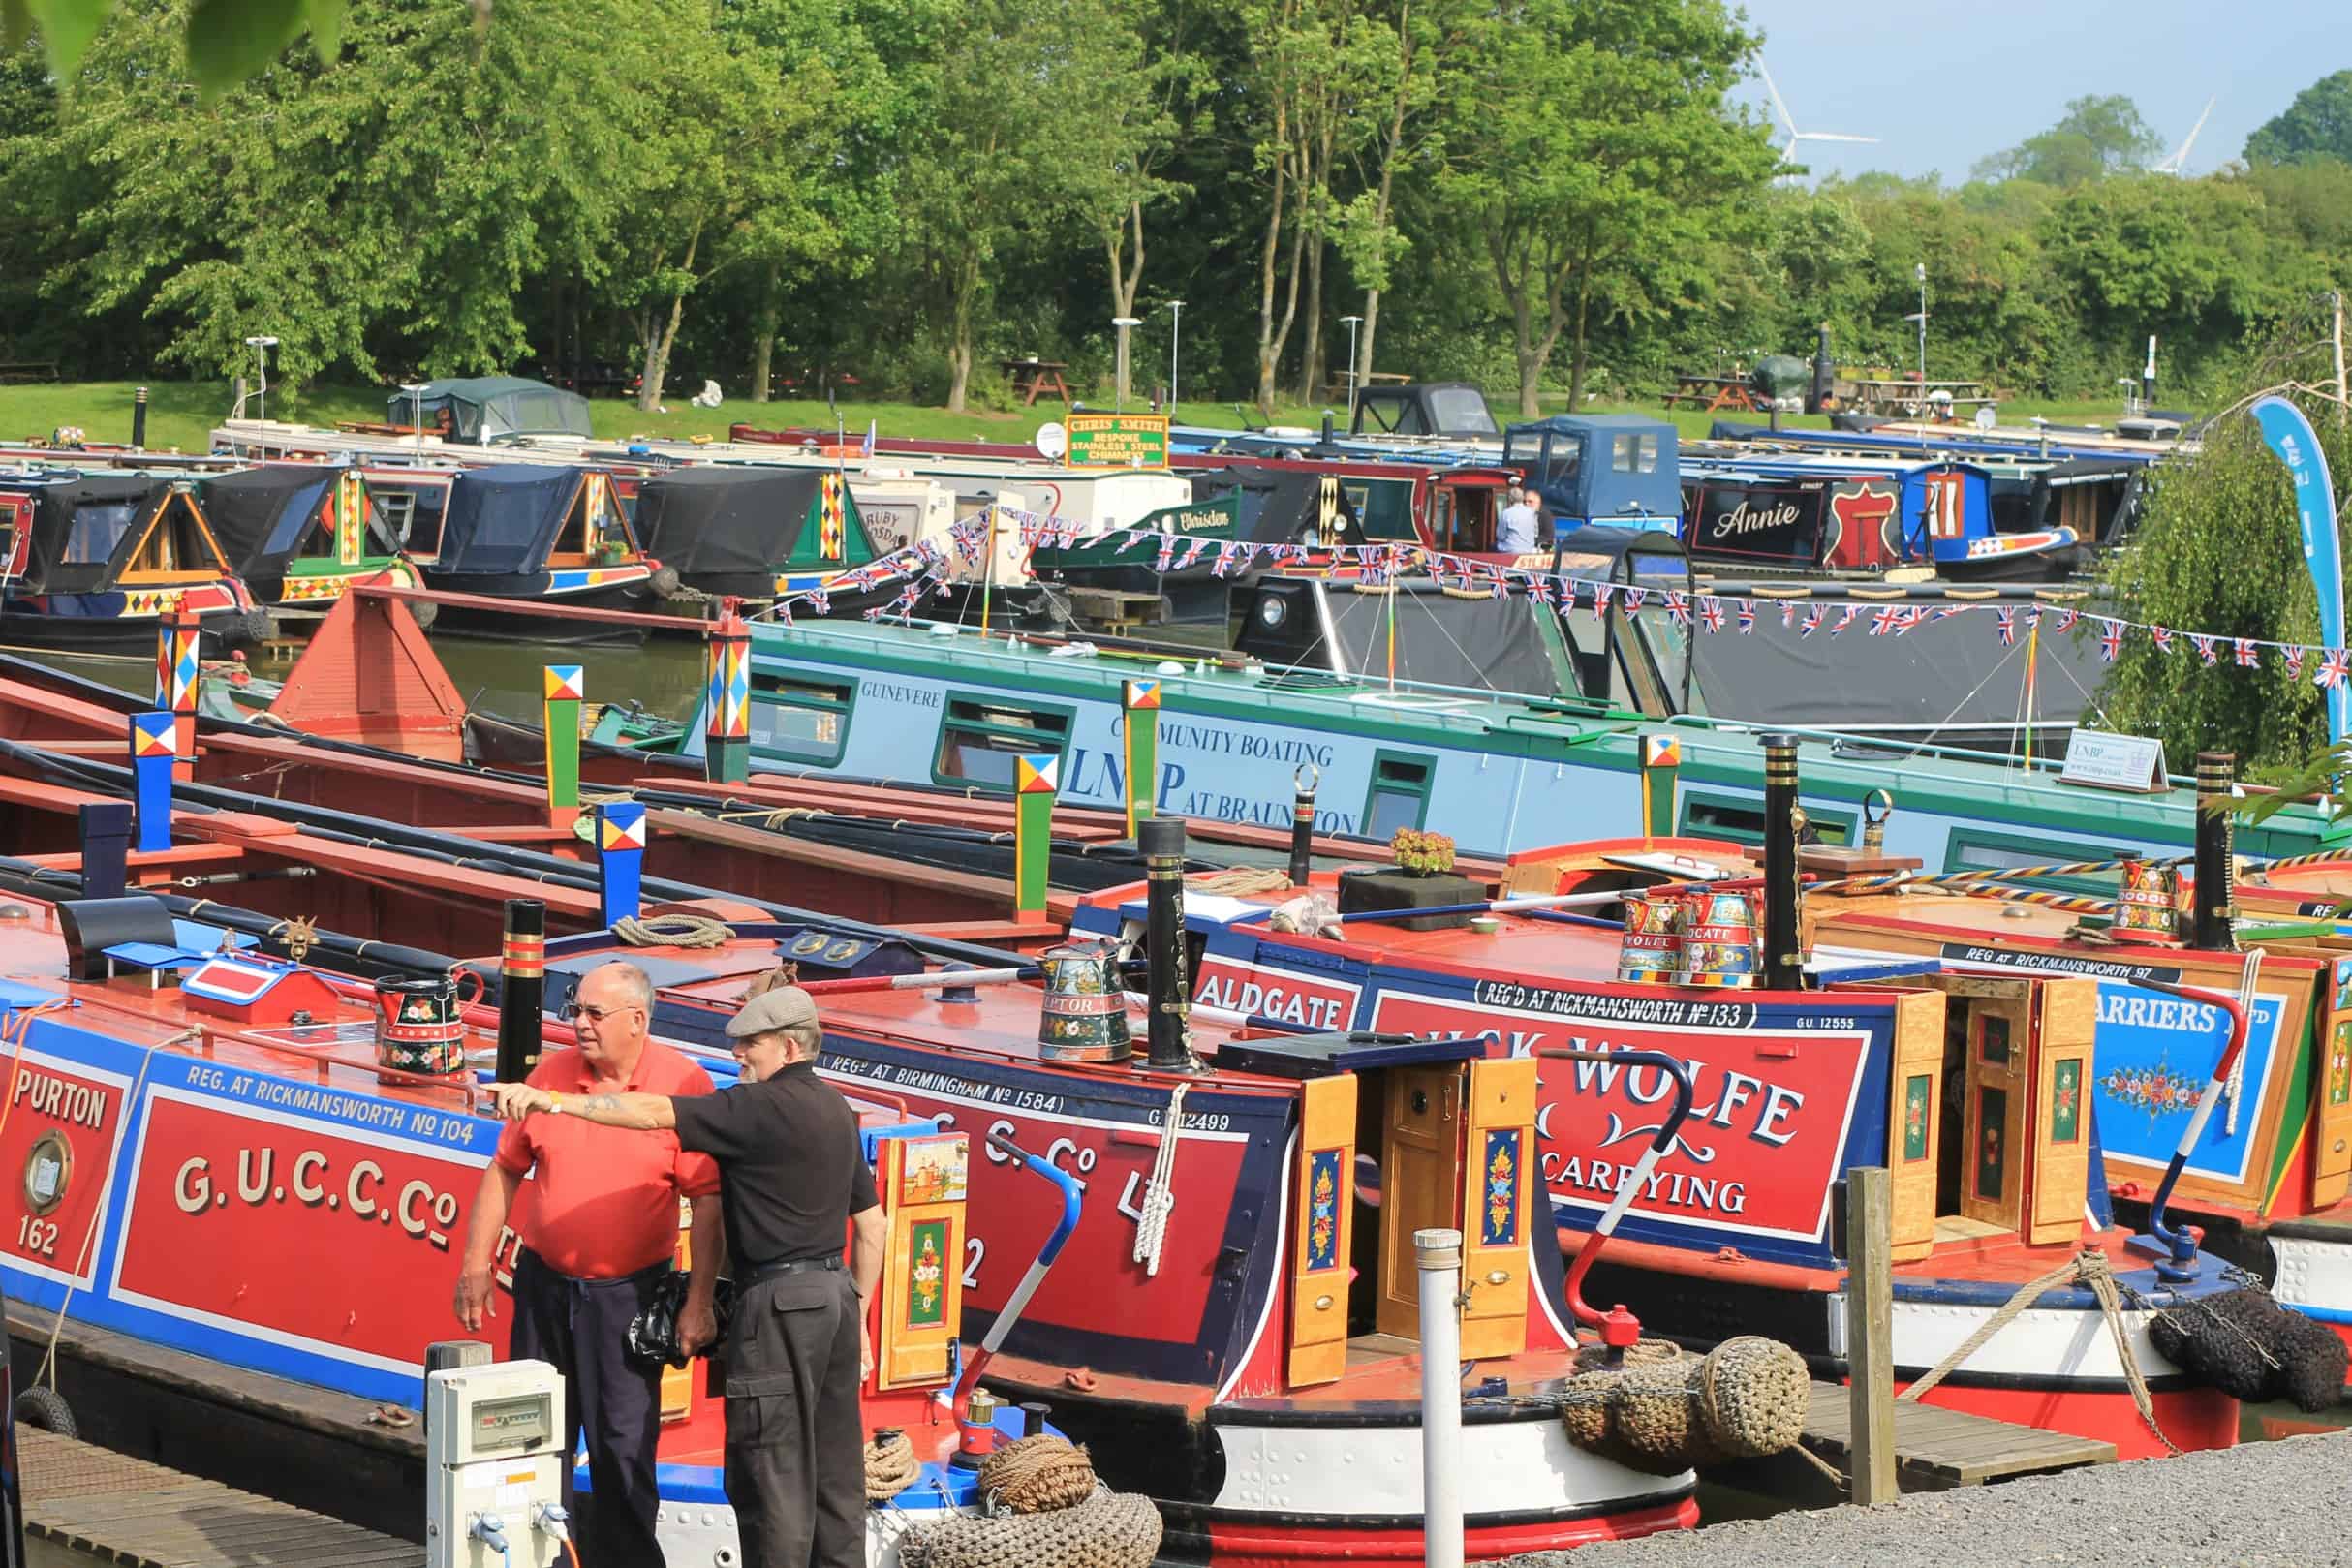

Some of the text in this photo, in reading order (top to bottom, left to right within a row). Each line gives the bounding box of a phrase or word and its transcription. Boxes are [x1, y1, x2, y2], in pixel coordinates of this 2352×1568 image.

[1070, 419, 1163, 432] CHRIS SMITH
[1093, 434, 1140, 443] BESPOKE
[1071, 443, 1161, 451] STAINLESS STEEL
[866, 510, 900, 528] RUBY
[1712, 501, 1801, 538] Annie
[861, 681, 942, 709] GUINEVERE
[1111, 716, 1335, 768] CMUNITY BOATING
[1066, 748, 1357, 835] LNP AT BRAUNTON
[1966, 947, 2153, 980] REG AT RICKMANSWORTH 97
[1195, 975, 1343, 1030] ALDGATE
[1528, 990, 1549, 1009] AT
[1550, 991, 1686, 1024] RICKMANSWORTH
[1820, 1017, 1854, 1029] 12555
[14, 1068, 108, 1129] PURTON
[870, 1063, 893, 1079] AT
[895, 1068, 988, 1100] BIRMINGHAM
[186, 1065, 225, 1091] REG.
[230, 1075, 251, 1096] AT
[255, 1080, 405, 1130] RICKMANSWORTH
[440, 1118, 475, 1146] 104
[17, 1214, 59, 1255] 162
